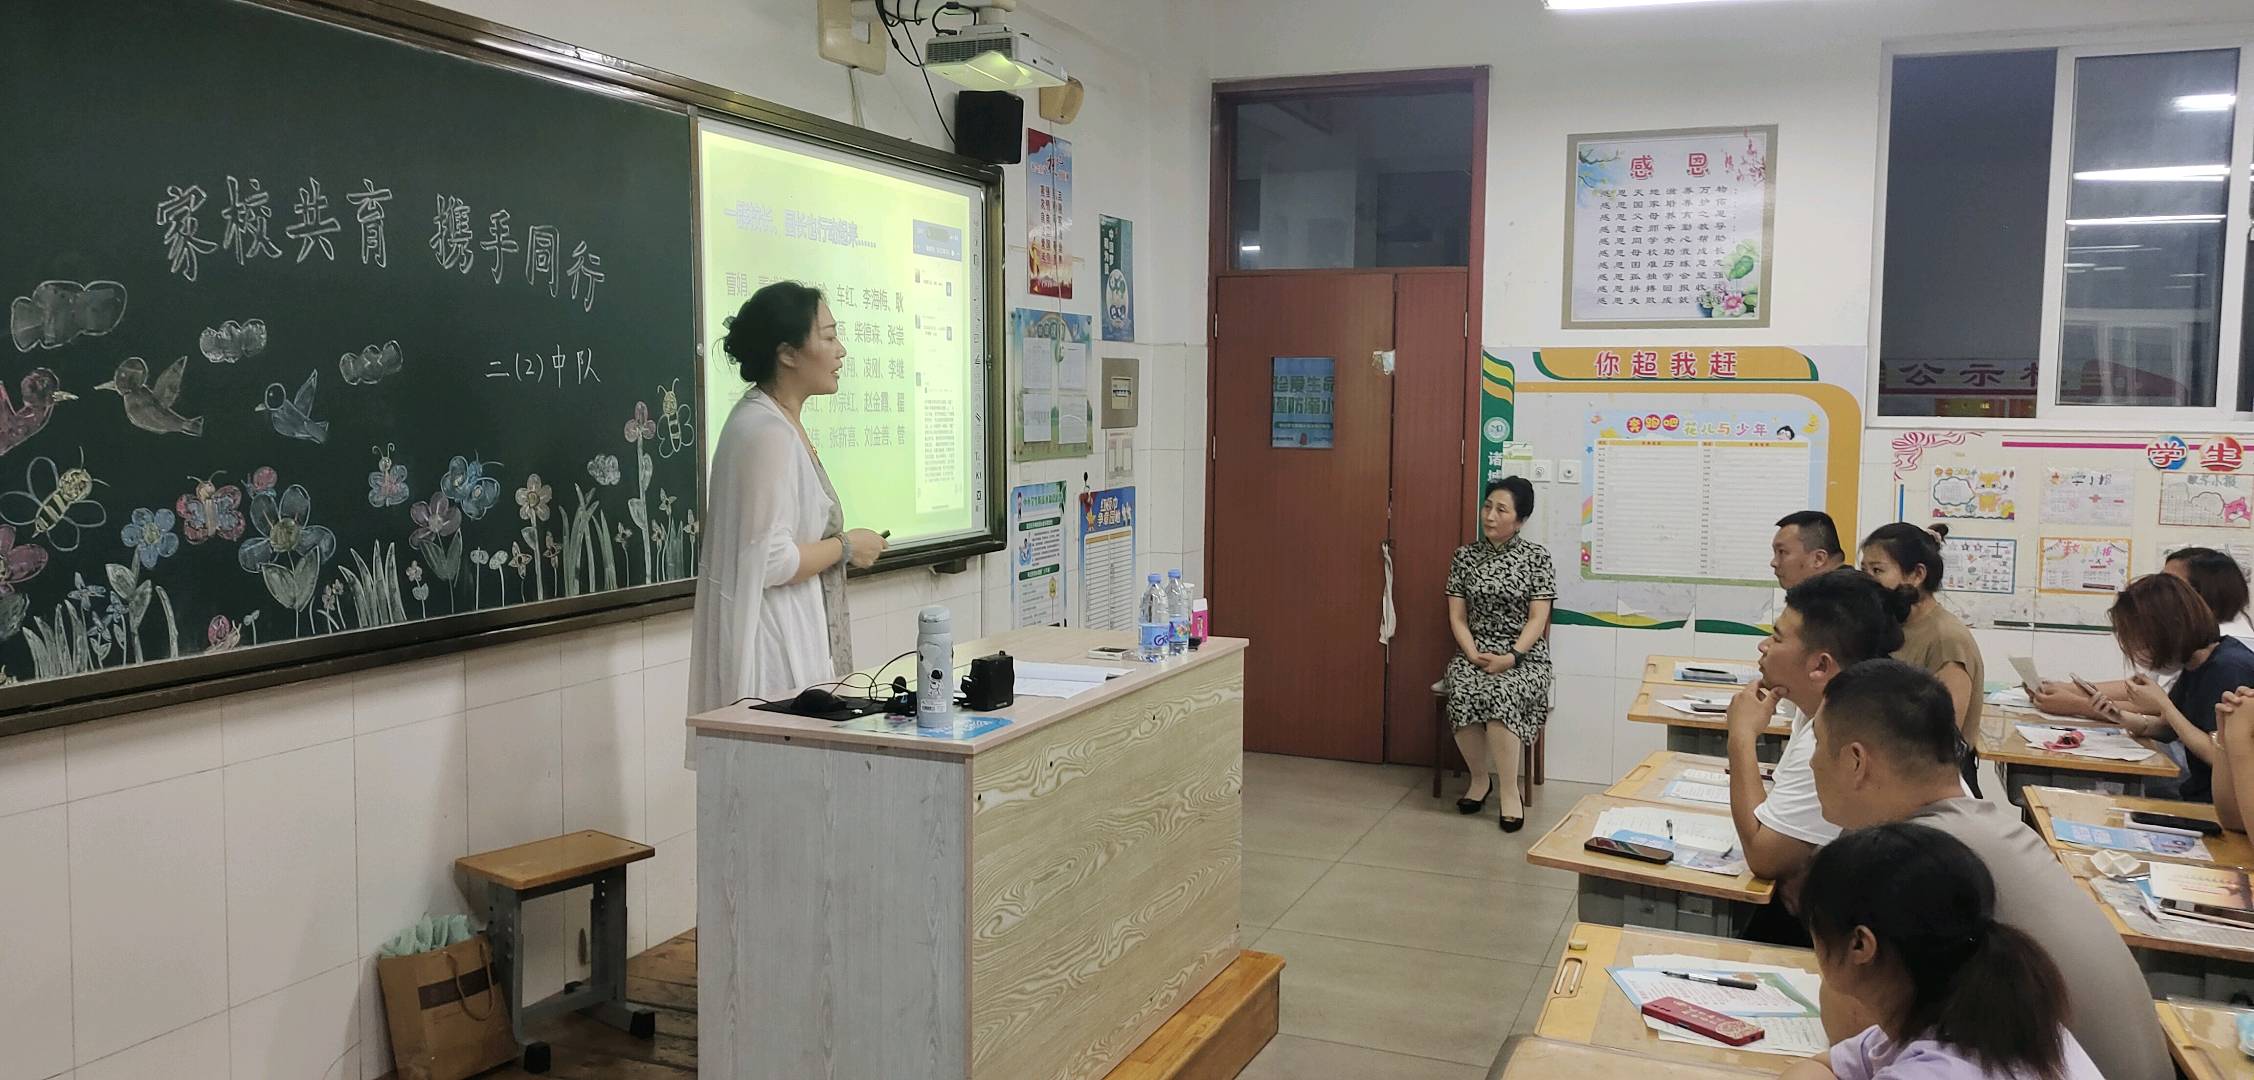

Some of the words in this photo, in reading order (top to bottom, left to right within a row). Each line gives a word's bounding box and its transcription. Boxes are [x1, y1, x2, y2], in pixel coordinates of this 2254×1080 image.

[1630, 152, 1709, 180] 感恩
[156, 175, 393, 282] 家校共育
[428, 193, 606, 313] 携手同行
[485, 343, 601, 388] 二(2)中队
[1595, 351, 1738, 378] 你超我赶
[1627, 415, 1680, 434] 奔跑吧
[1684, 422, 1768, 437] 花儿与少年
[2146, 438, 2245, 469] 学生
